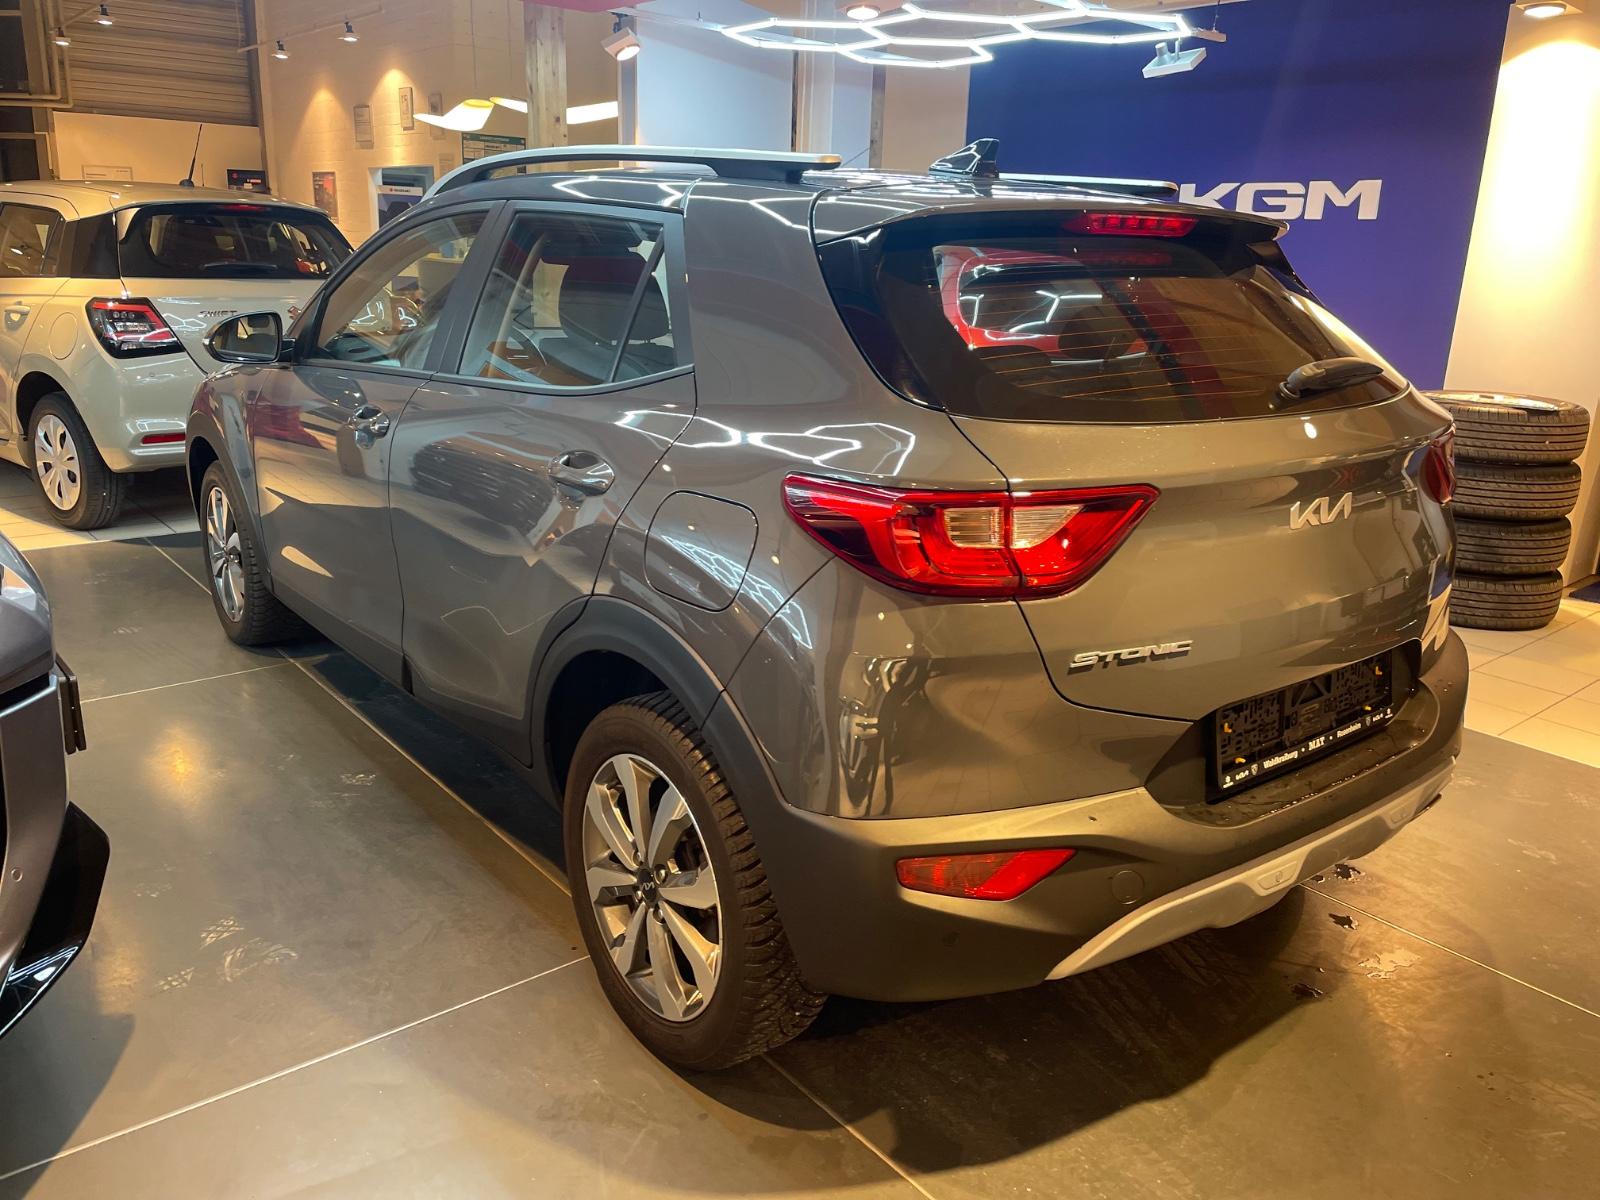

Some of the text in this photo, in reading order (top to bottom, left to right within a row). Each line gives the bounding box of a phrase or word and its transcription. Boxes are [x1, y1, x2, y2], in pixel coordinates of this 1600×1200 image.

[1179, 179, 1382, 220] KGM
[199, 310, 238, 318] SWIFT
[1289, 492, 1352, 529] KIA
[1069, 640, 1193, 668] STONIC
